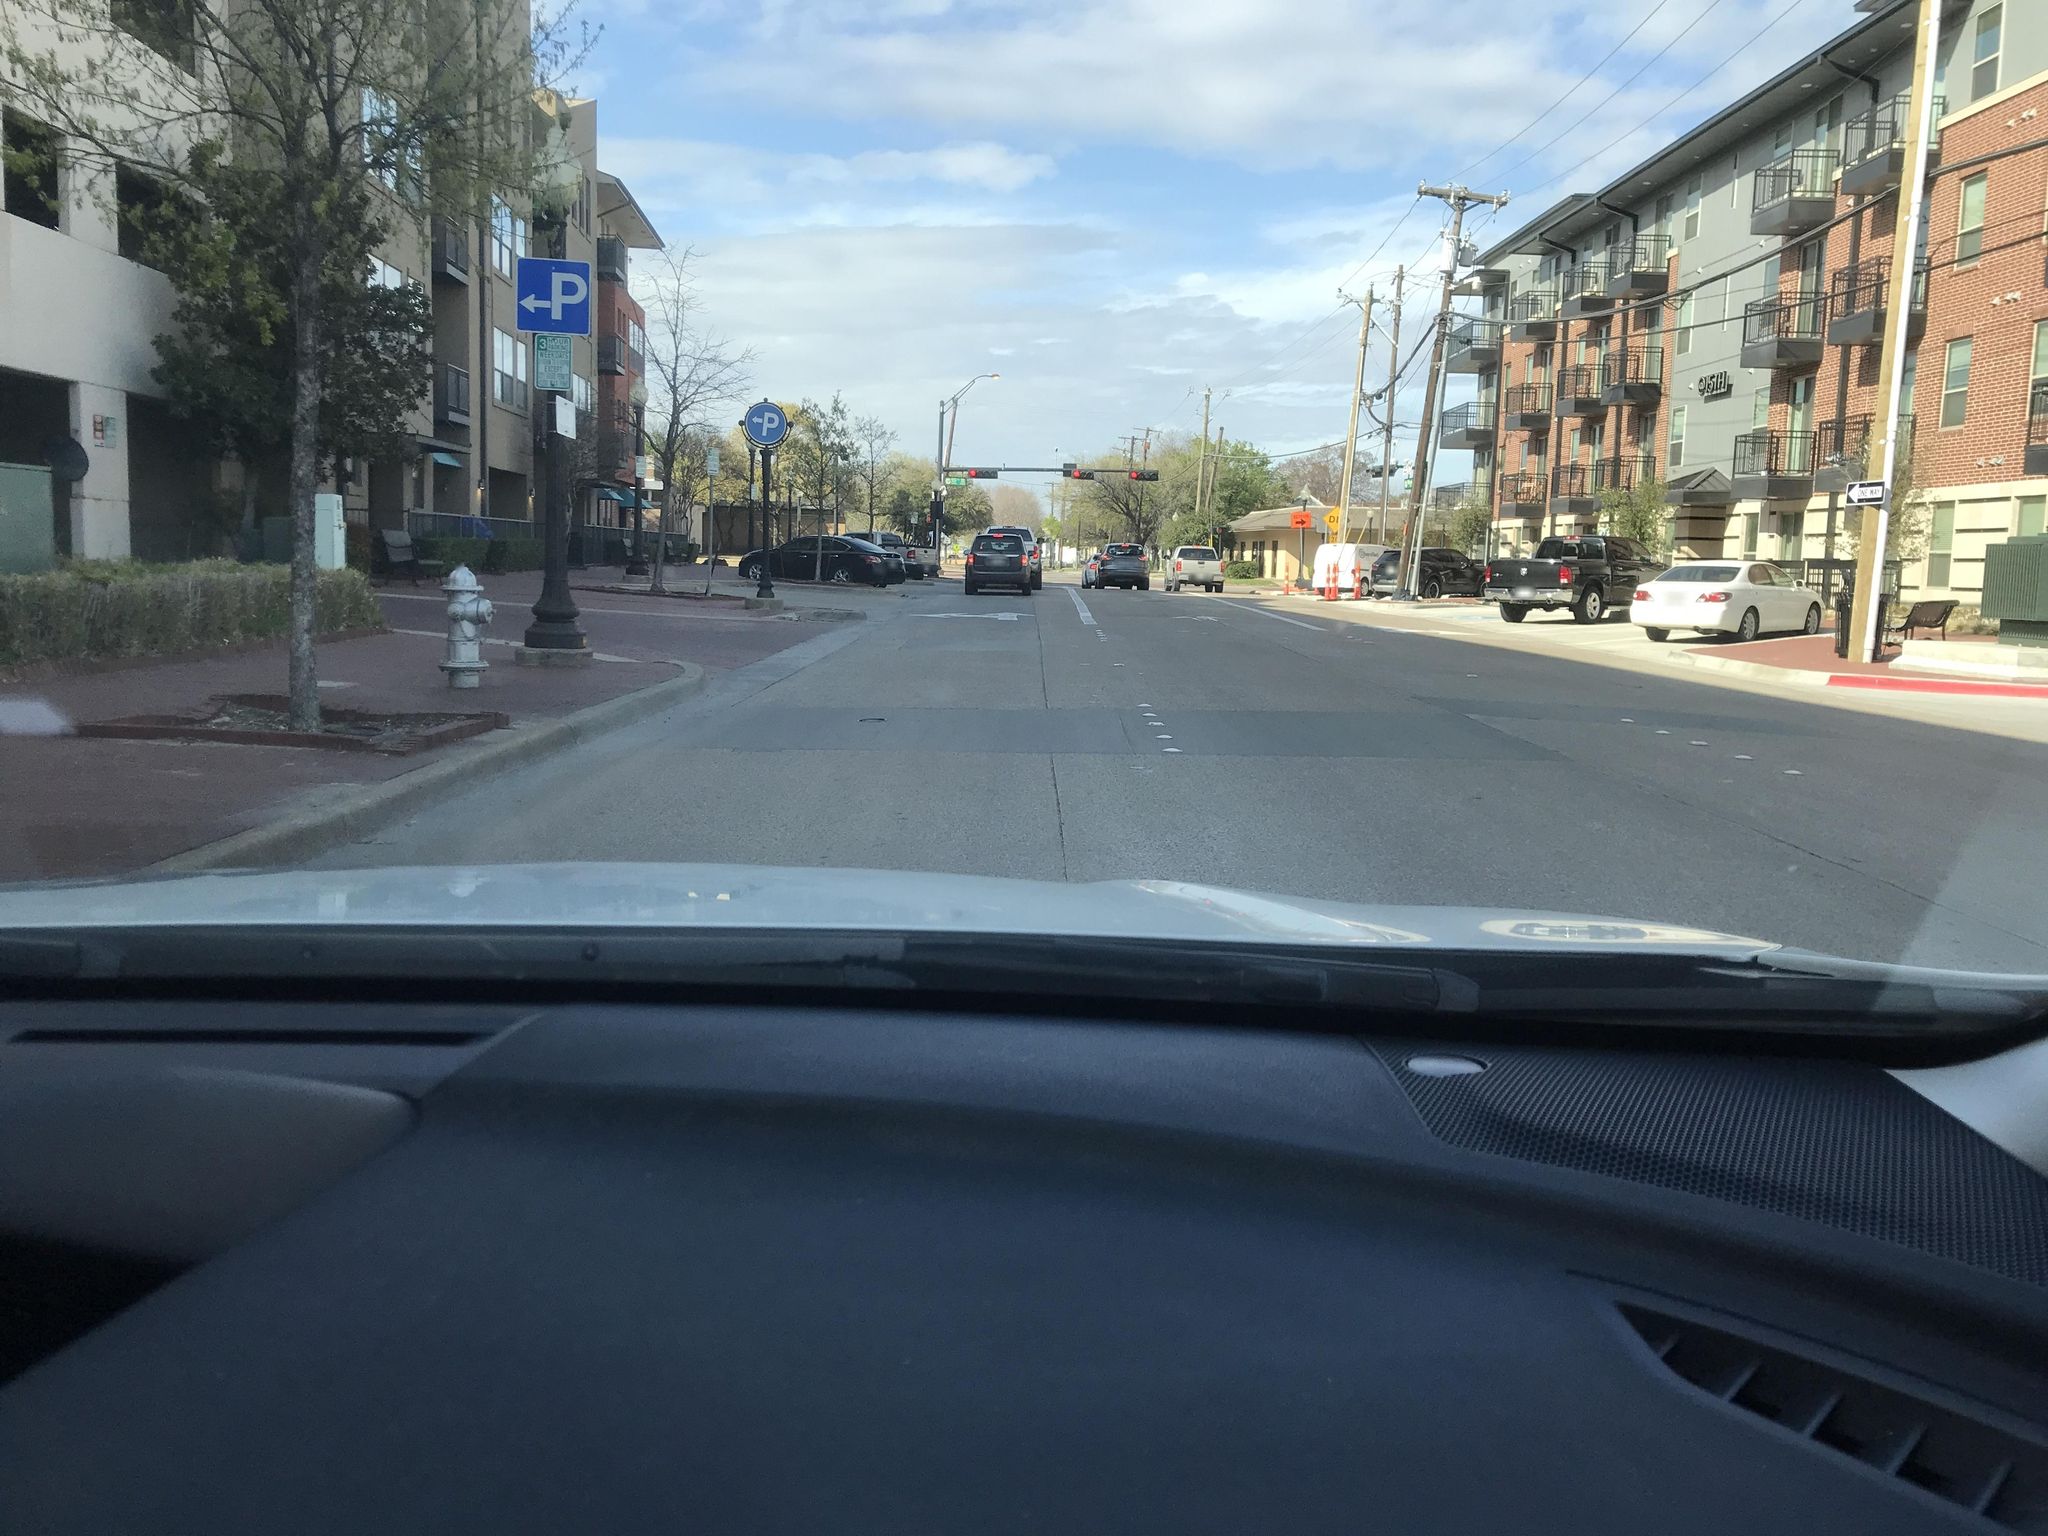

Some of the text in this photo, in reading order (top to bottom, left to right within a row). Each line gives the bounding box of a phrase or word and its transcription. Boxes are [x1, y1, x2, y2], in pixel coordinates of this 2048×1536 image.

[551, 272, 588, 321] P
[539, 338, 547, 350] 3
[761, 412, 780, 437] P
[1857, 488, 1881, 498] ONE WAY
[1328, 515, 1339, 524] DI
